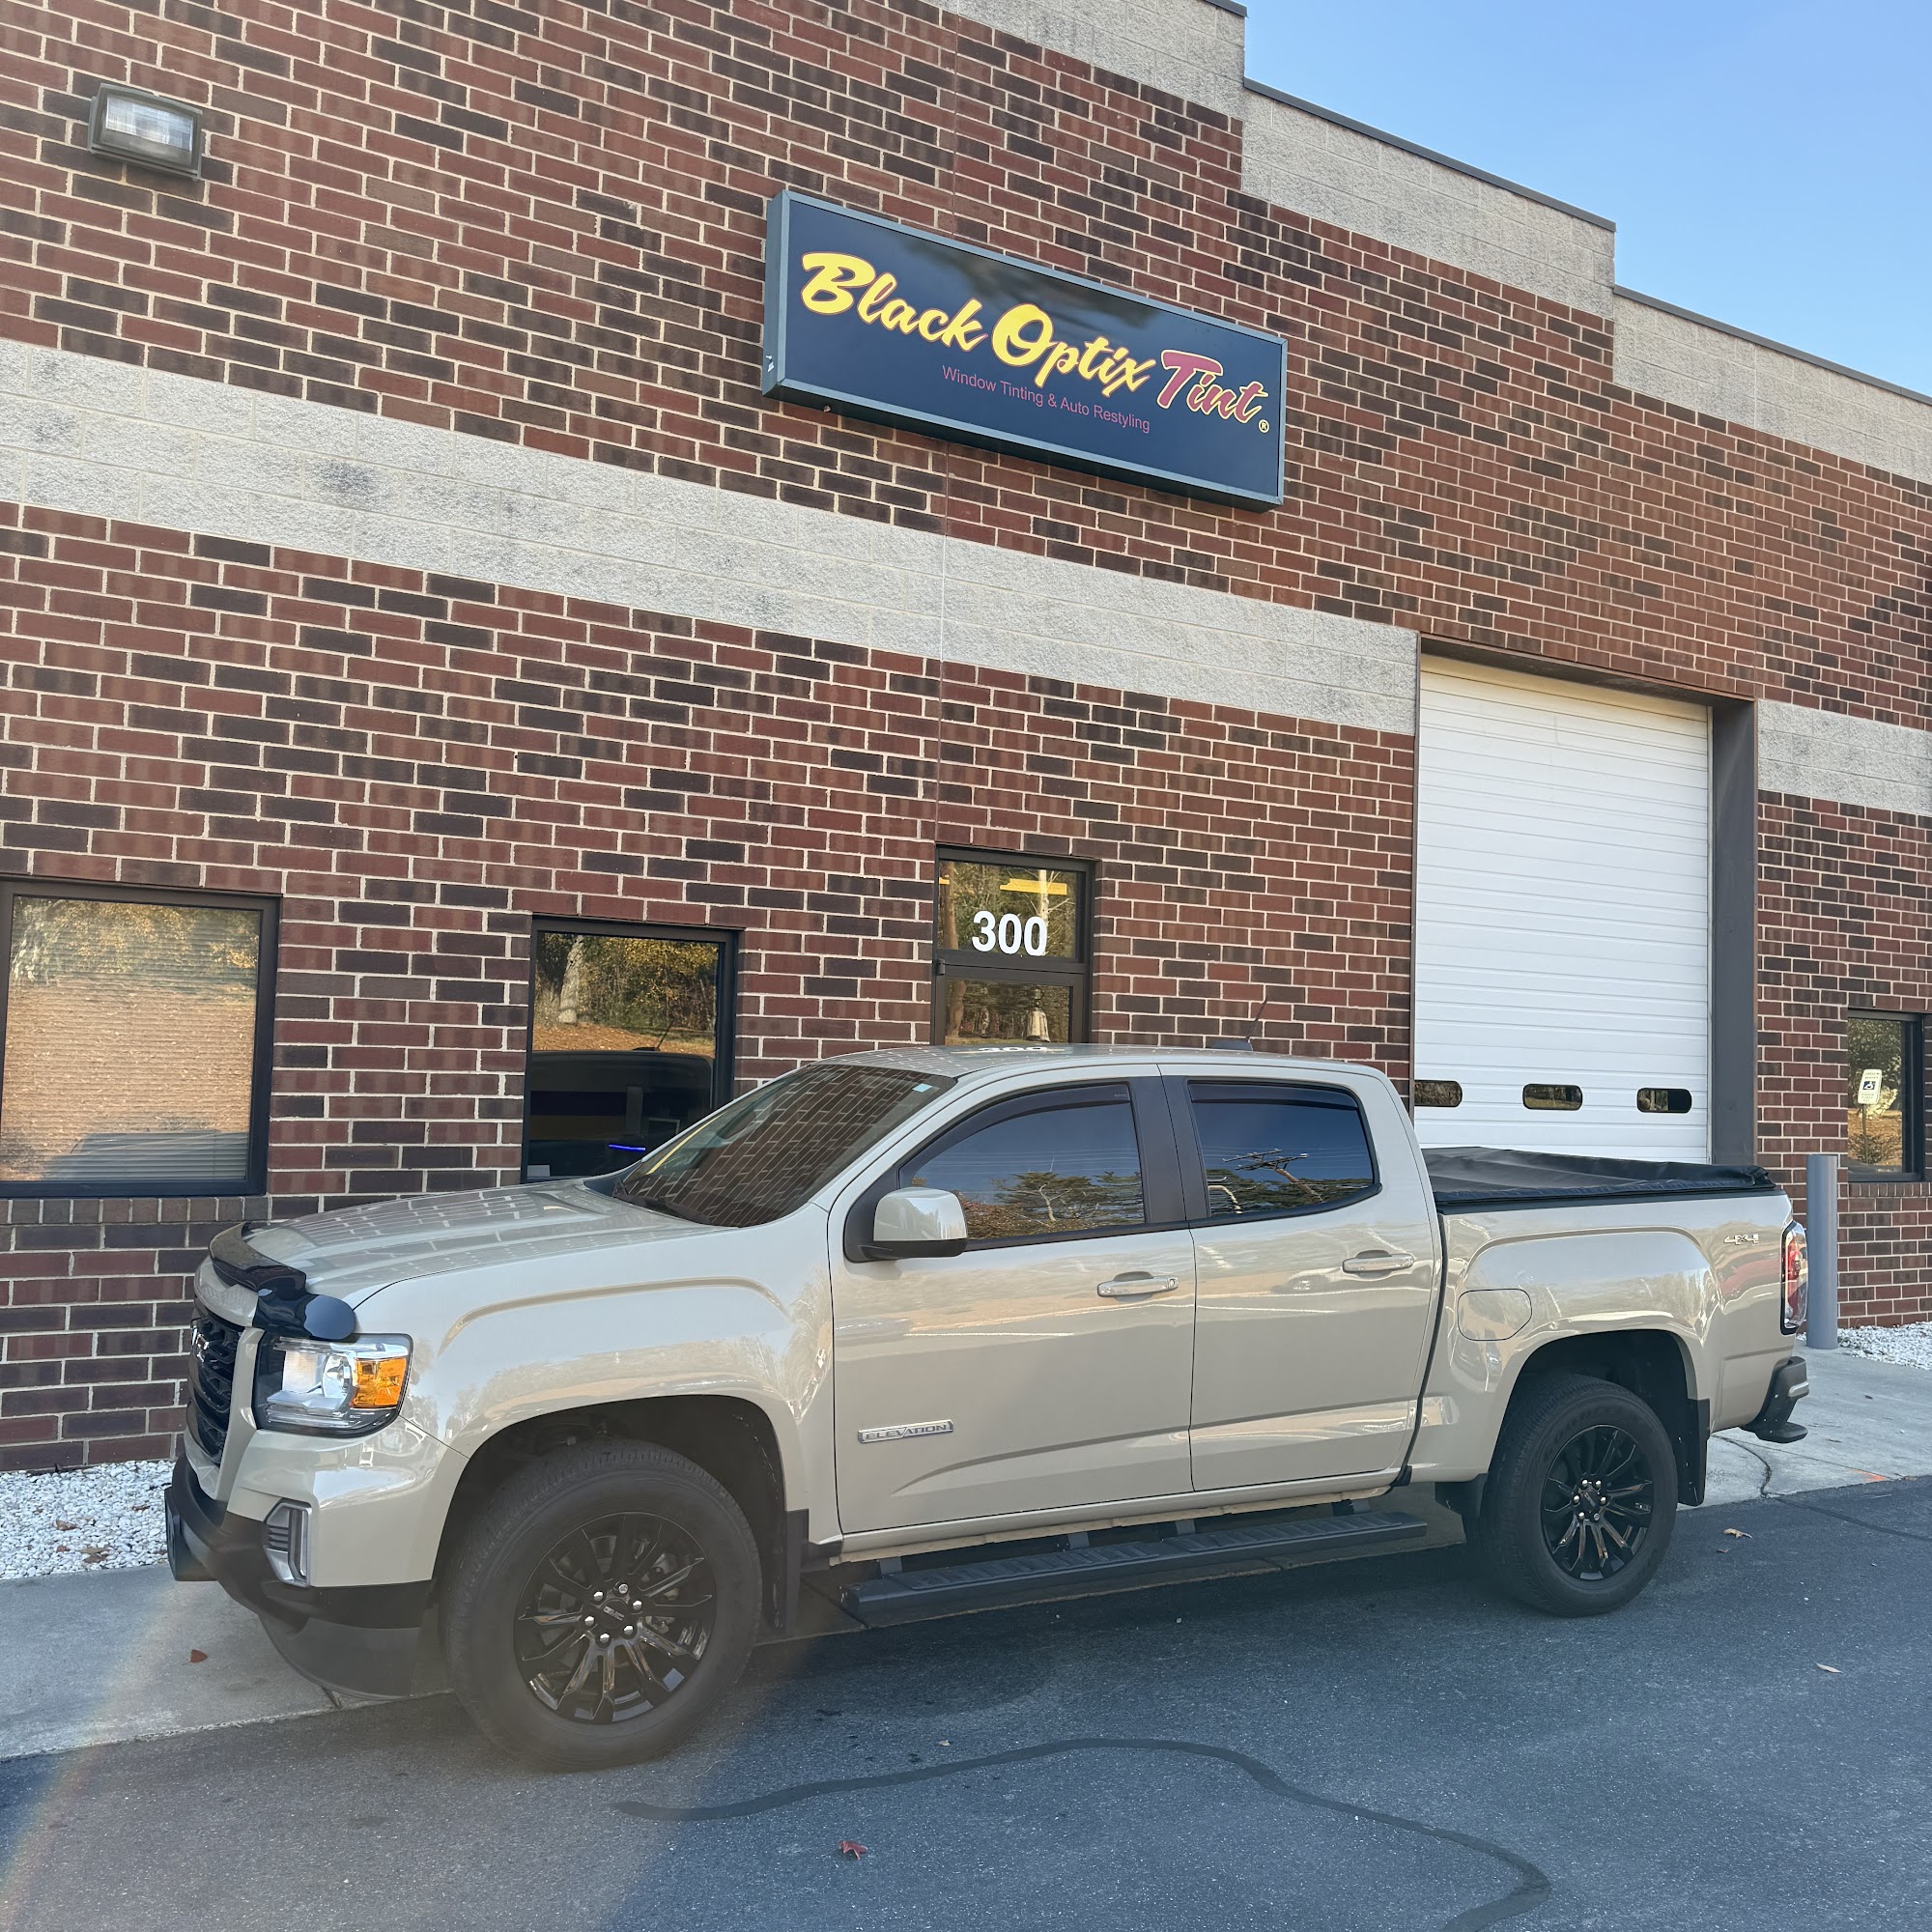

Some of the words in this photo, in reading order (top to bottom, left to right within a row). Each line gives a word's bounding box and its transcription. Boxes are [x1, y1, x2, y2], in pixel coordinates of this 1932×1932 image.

[801, 251, 988, 352] Black
[991, 302, 1156, 397] Optix
[942, 365, 996, 391] Window
[1000, 381, 1043, 407] Tinting
[1047, 393, 1057, 408] &
[1060, 397, 1090, 415] Auto
[1094, 405, 1150, 434] Restyling
[972, 910, 1047, 956] 300
[865, 1424, 947, 1440] ELEVATION
